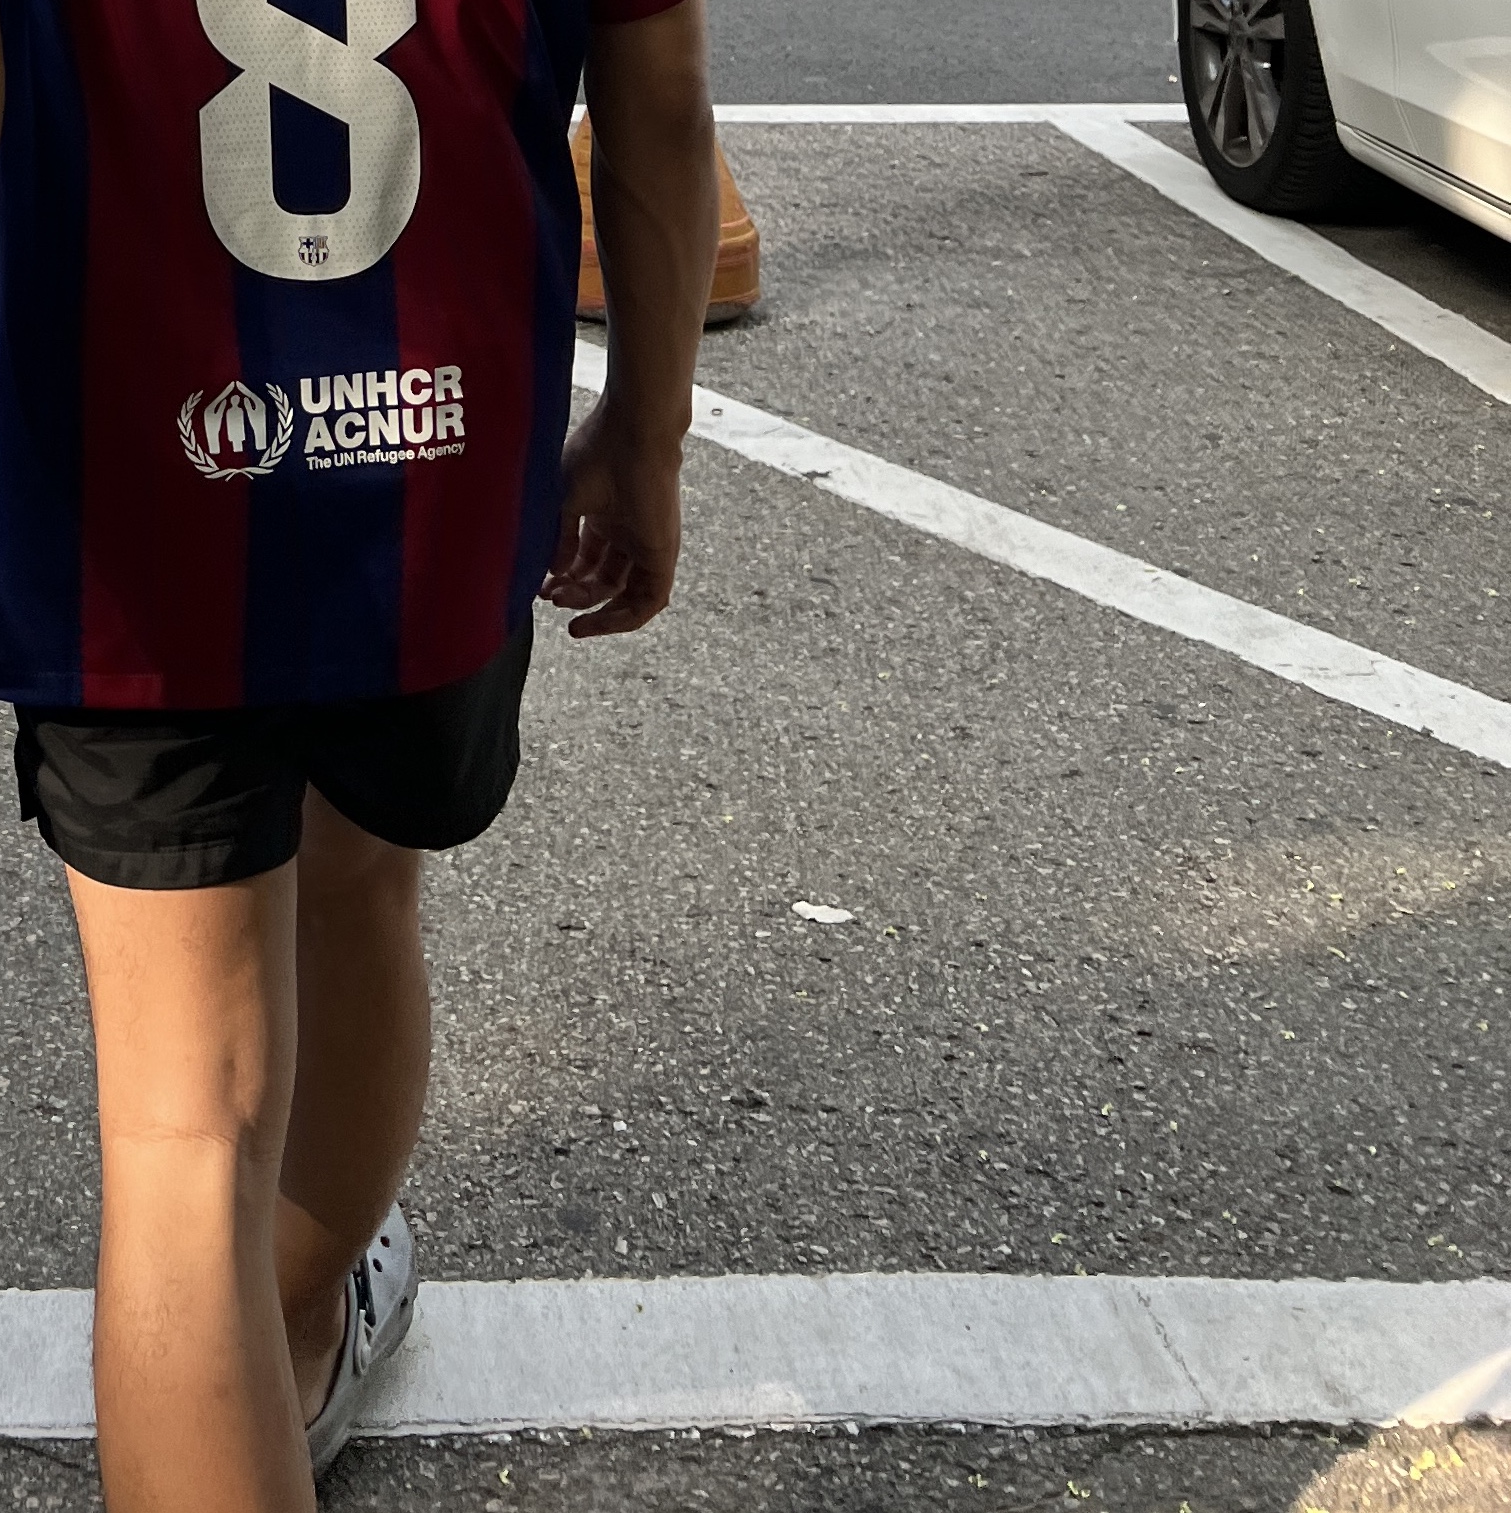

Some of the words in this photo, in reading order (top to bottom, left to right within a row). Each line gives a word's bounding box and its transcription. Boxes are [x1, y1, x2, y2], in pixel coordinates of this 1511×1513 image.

[300, 365, 464, 414] UNHCR
[304, 403, 466, 453] ACNUR
[306, 456, 332, 470] The
[334, 452, 355, 467] UN
[357, 449, 415, 465] Refugee
[417, 442, 466, 461] Agency
